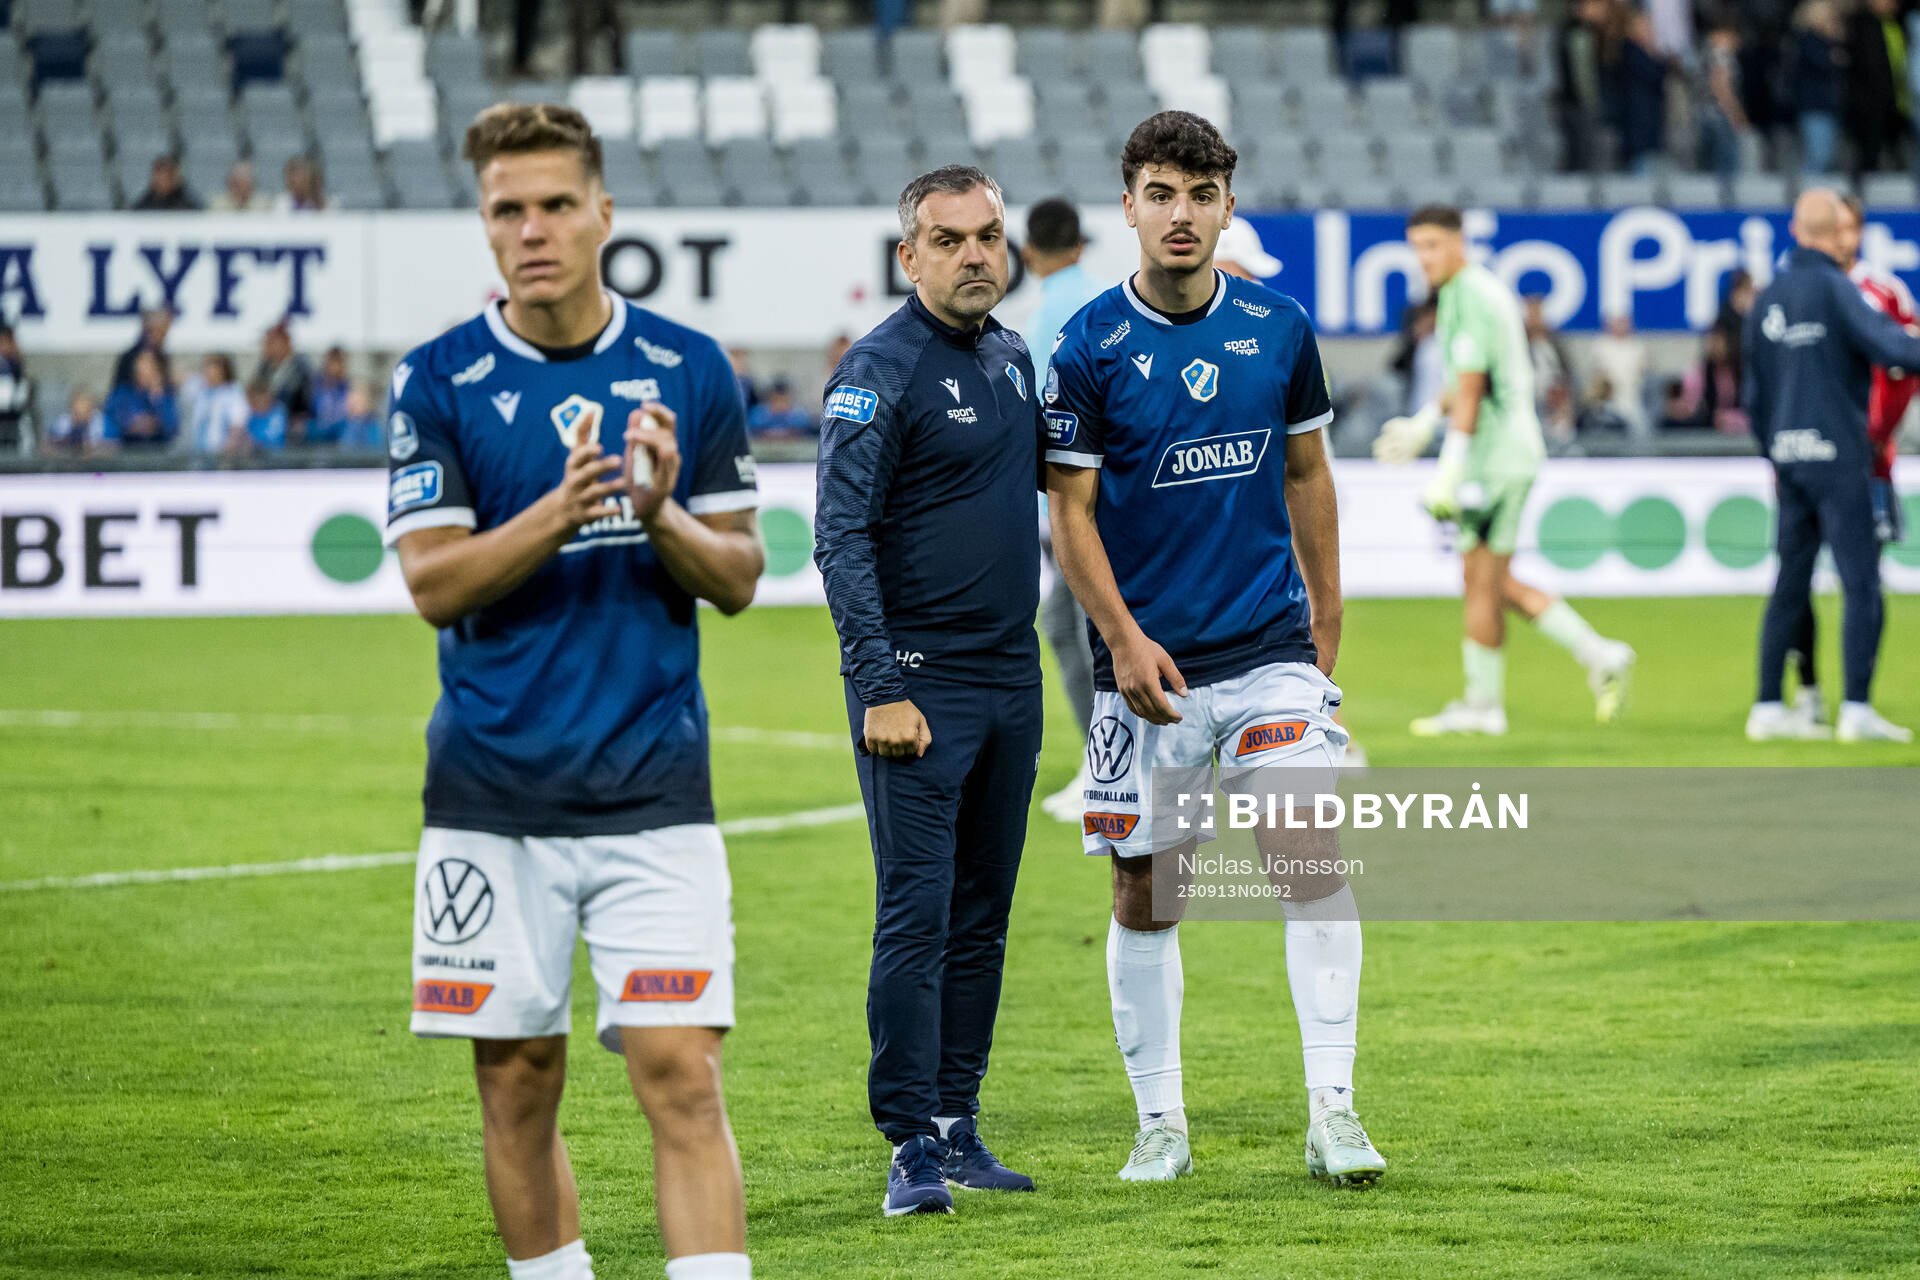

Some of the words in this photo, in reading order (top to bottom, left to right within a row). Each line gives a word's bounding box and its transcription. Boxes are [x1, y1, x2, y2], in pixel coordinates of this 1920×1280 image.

[87, 245, 326, 317] LYFT
[600, 238, 729, 299] OT
[1224, 337, 1259, 352] sport
[946, 406, 976, 420] sport
[1171, 440, 1254, 475] JONAB
[0, 512, 220, 589] BET
[895, 650, 924, 668] HC
[1245, 726, 1296, 749] JONAB
